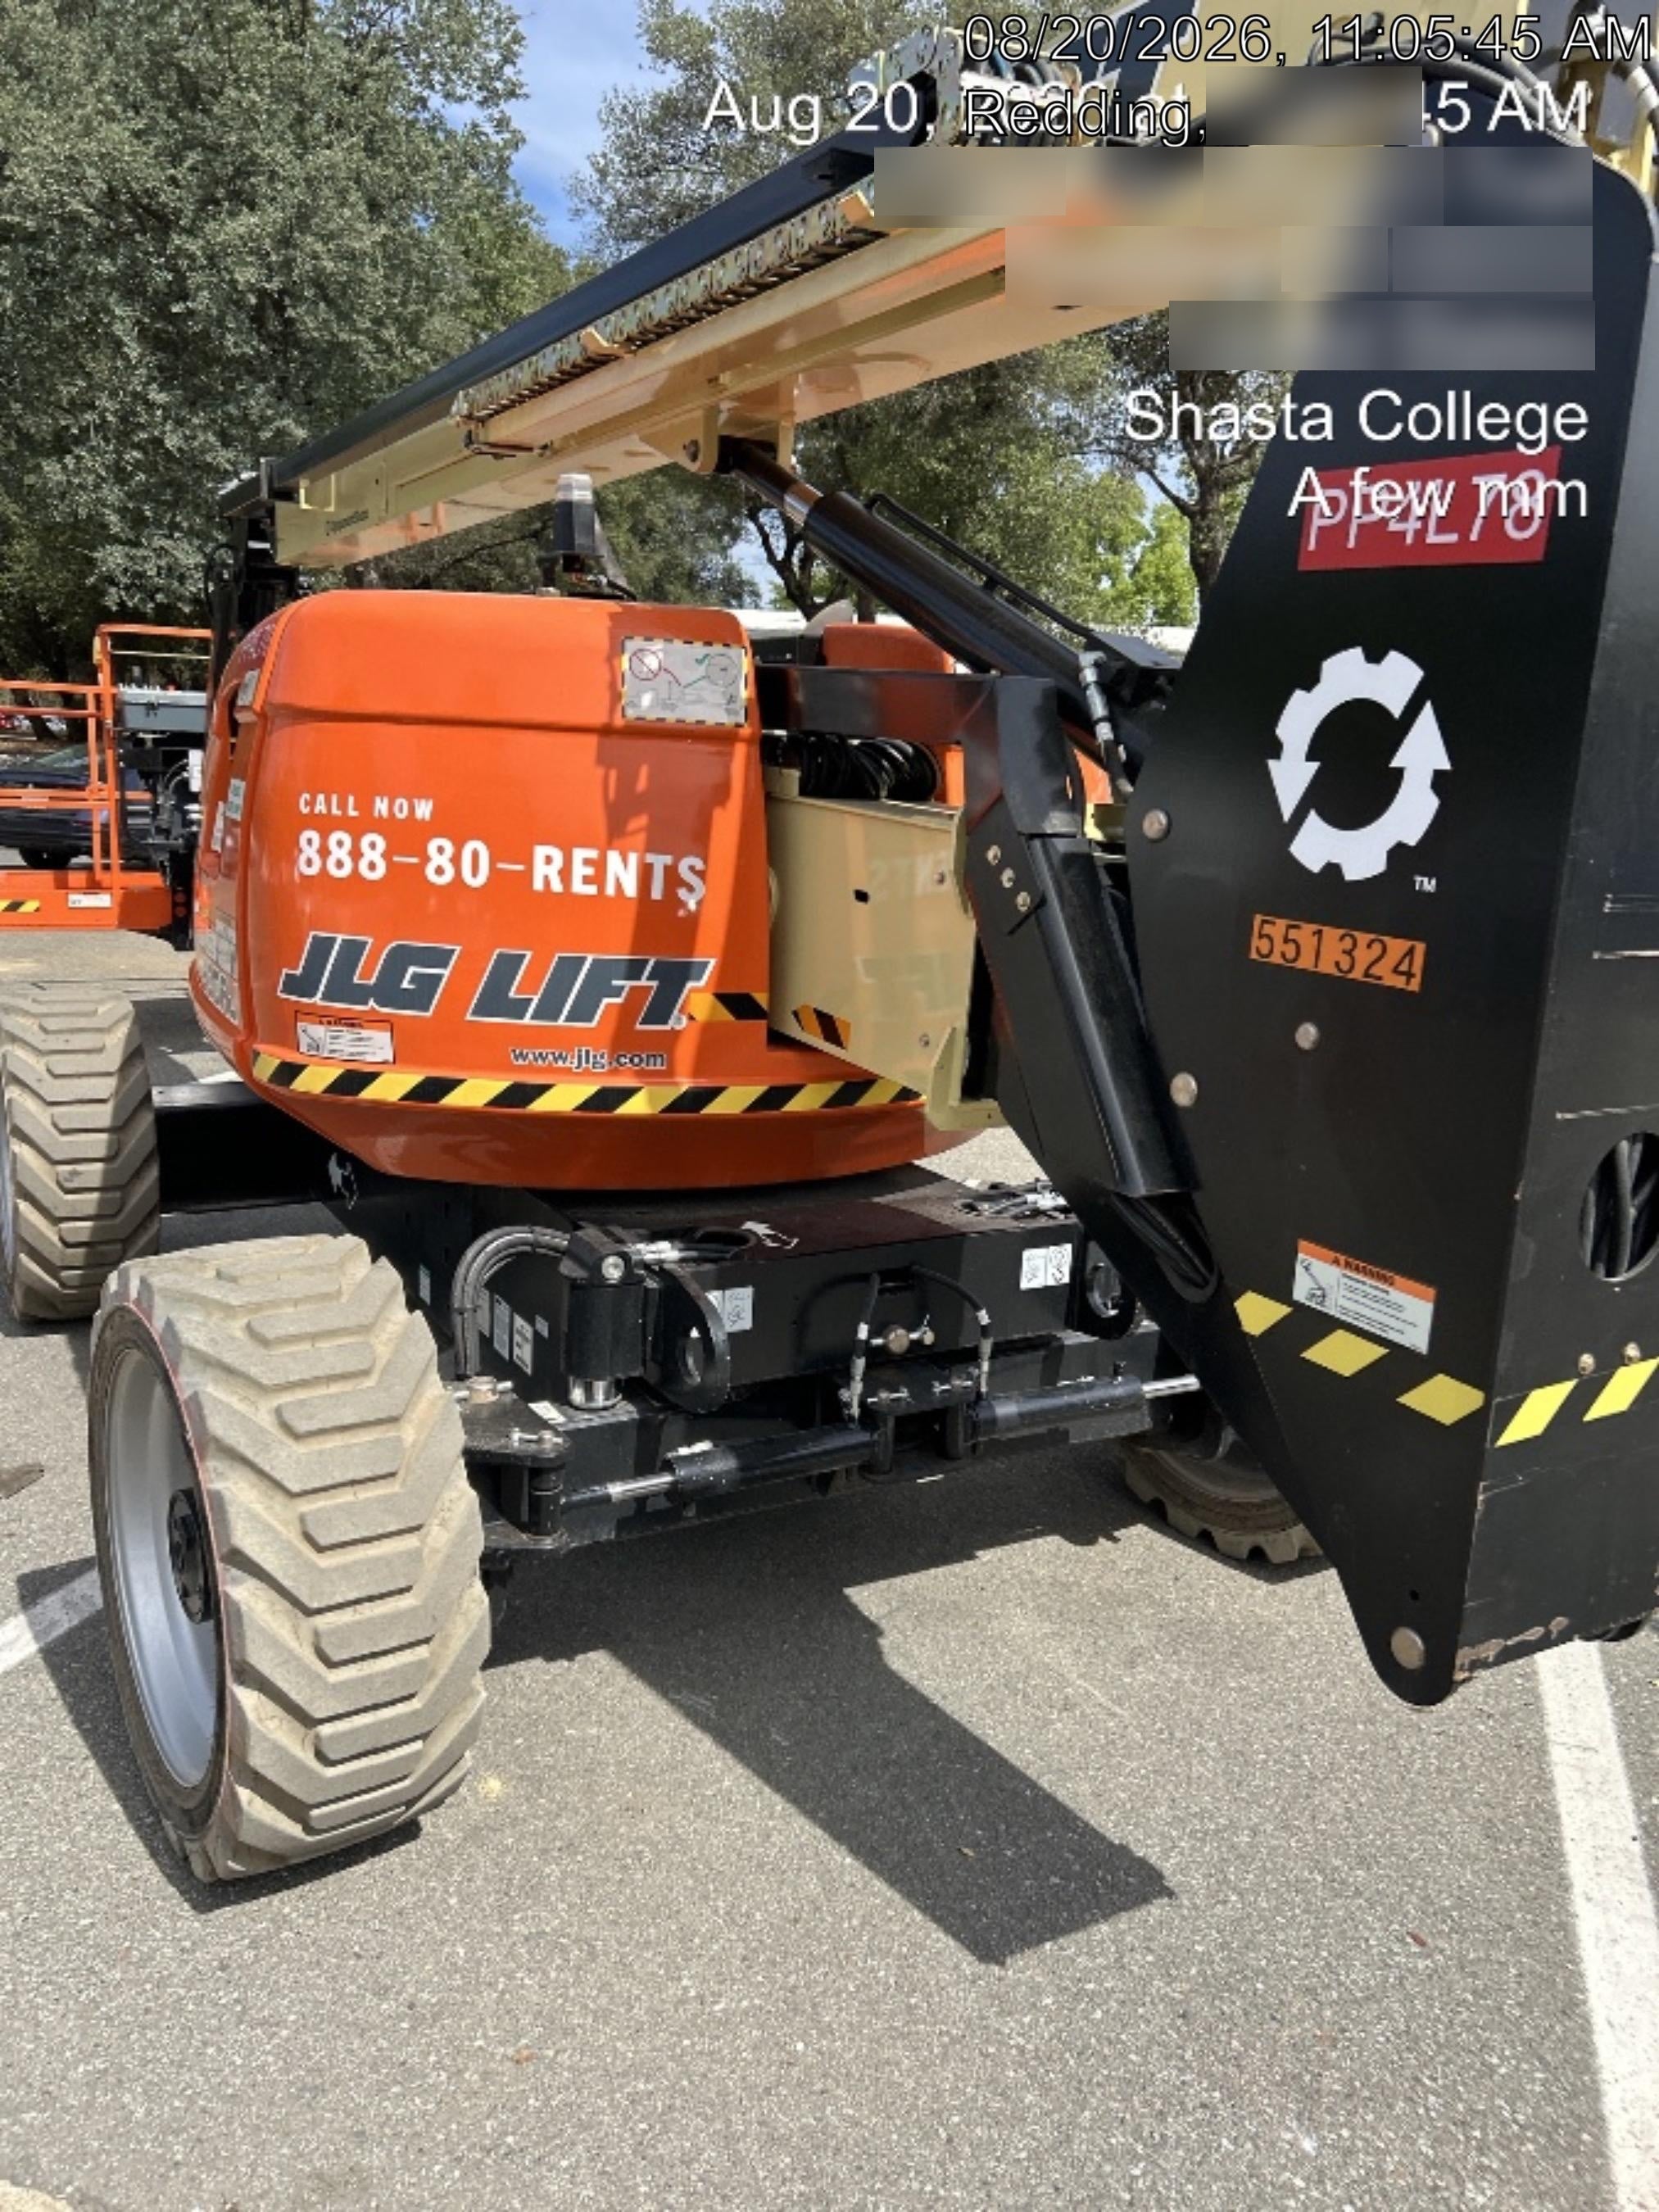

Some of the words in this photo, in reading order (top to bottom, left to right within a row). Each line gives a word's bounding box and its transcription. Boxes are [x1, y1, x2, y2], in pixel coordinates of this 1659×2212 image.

[299, 793, 360, 817] CALL
[374, 796, 434, 822] NOW
[298, 829, 706, 903] 888-80-RENTS
[278, 931, 462, 1015] JLG
[465, 949, 716, 1031] LIFT
[1256, 919, 1416, 986] 551324
[510, 1047, 668, 1072] www.jlg.com
